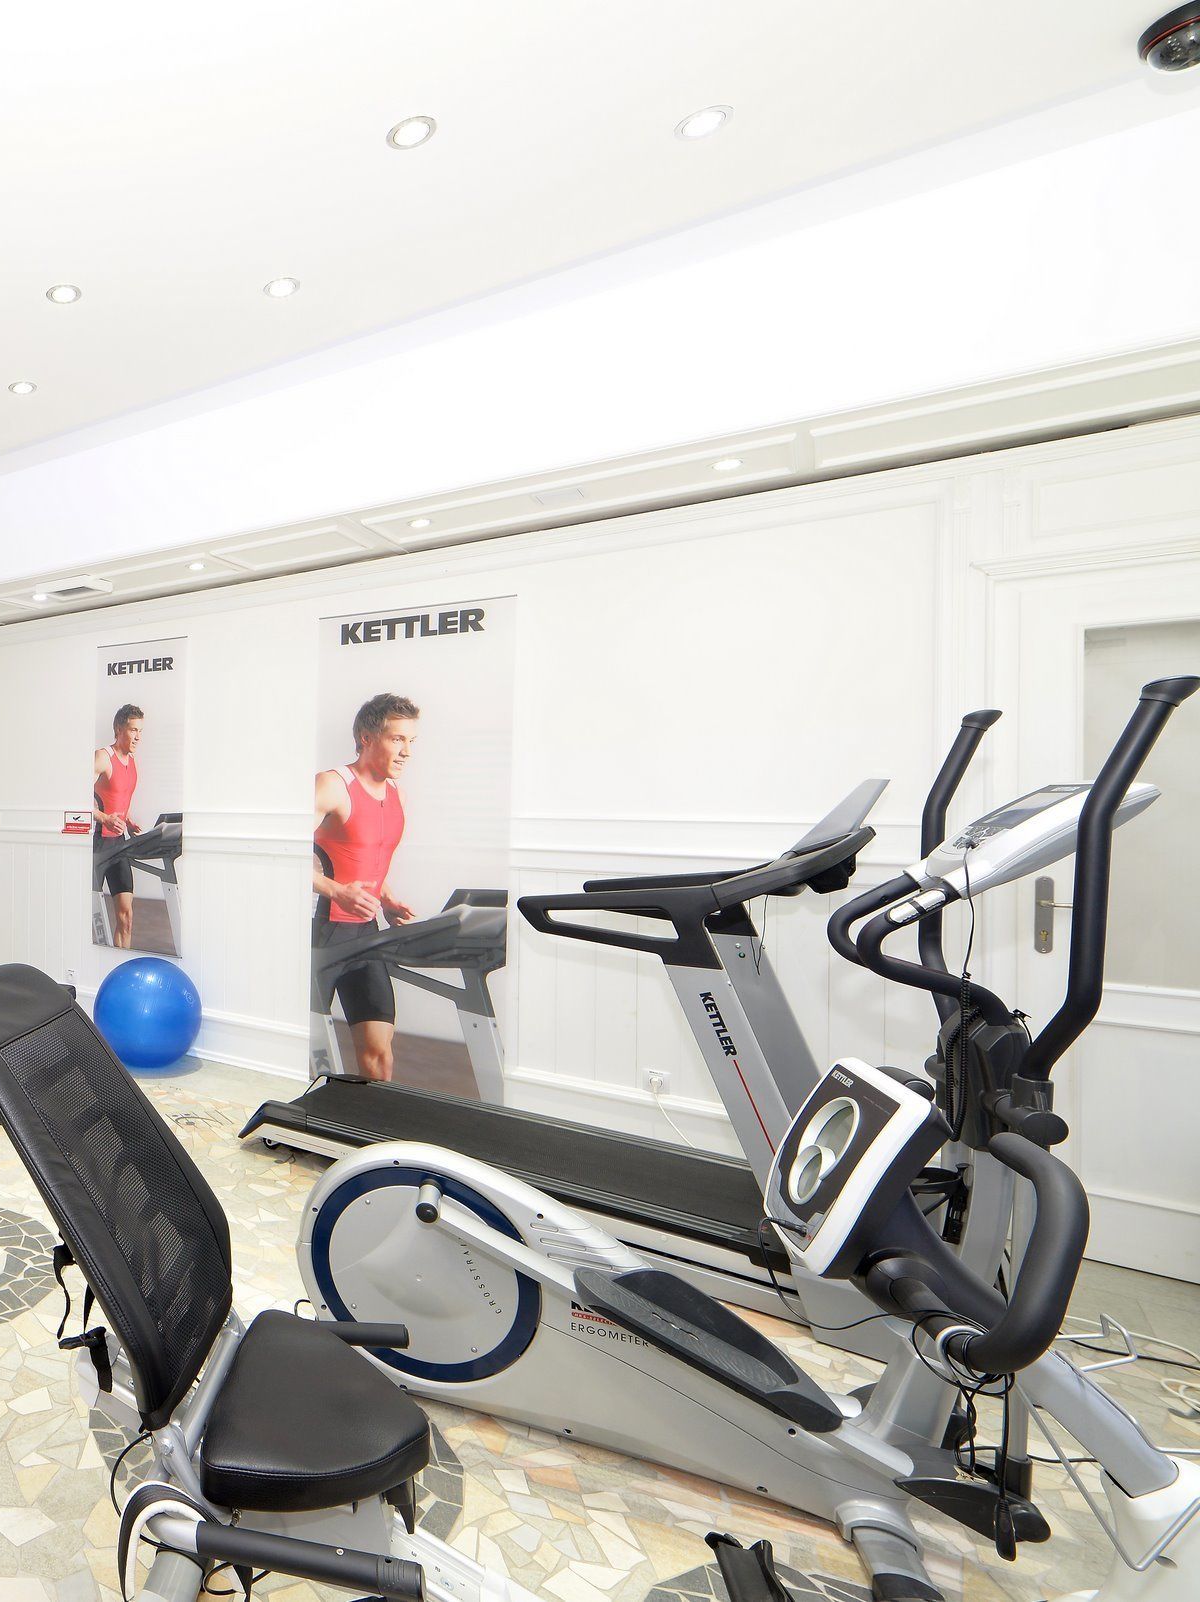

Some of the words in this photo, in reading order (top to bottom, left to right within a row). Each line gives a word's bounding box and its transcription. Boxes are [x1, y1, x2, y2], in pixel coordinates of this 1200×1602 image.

[340, 607, 485, 646] KETTLER
[107, 656, 174, 676] KETTLER
[699, 991, 738, 1057] KETTLER
[831, 1069, 854, 1088] KETTLER
[459, 1237, 502, 1315] CROSSTRAI
[571, 1321, 650, 1348] ERGOMETER
